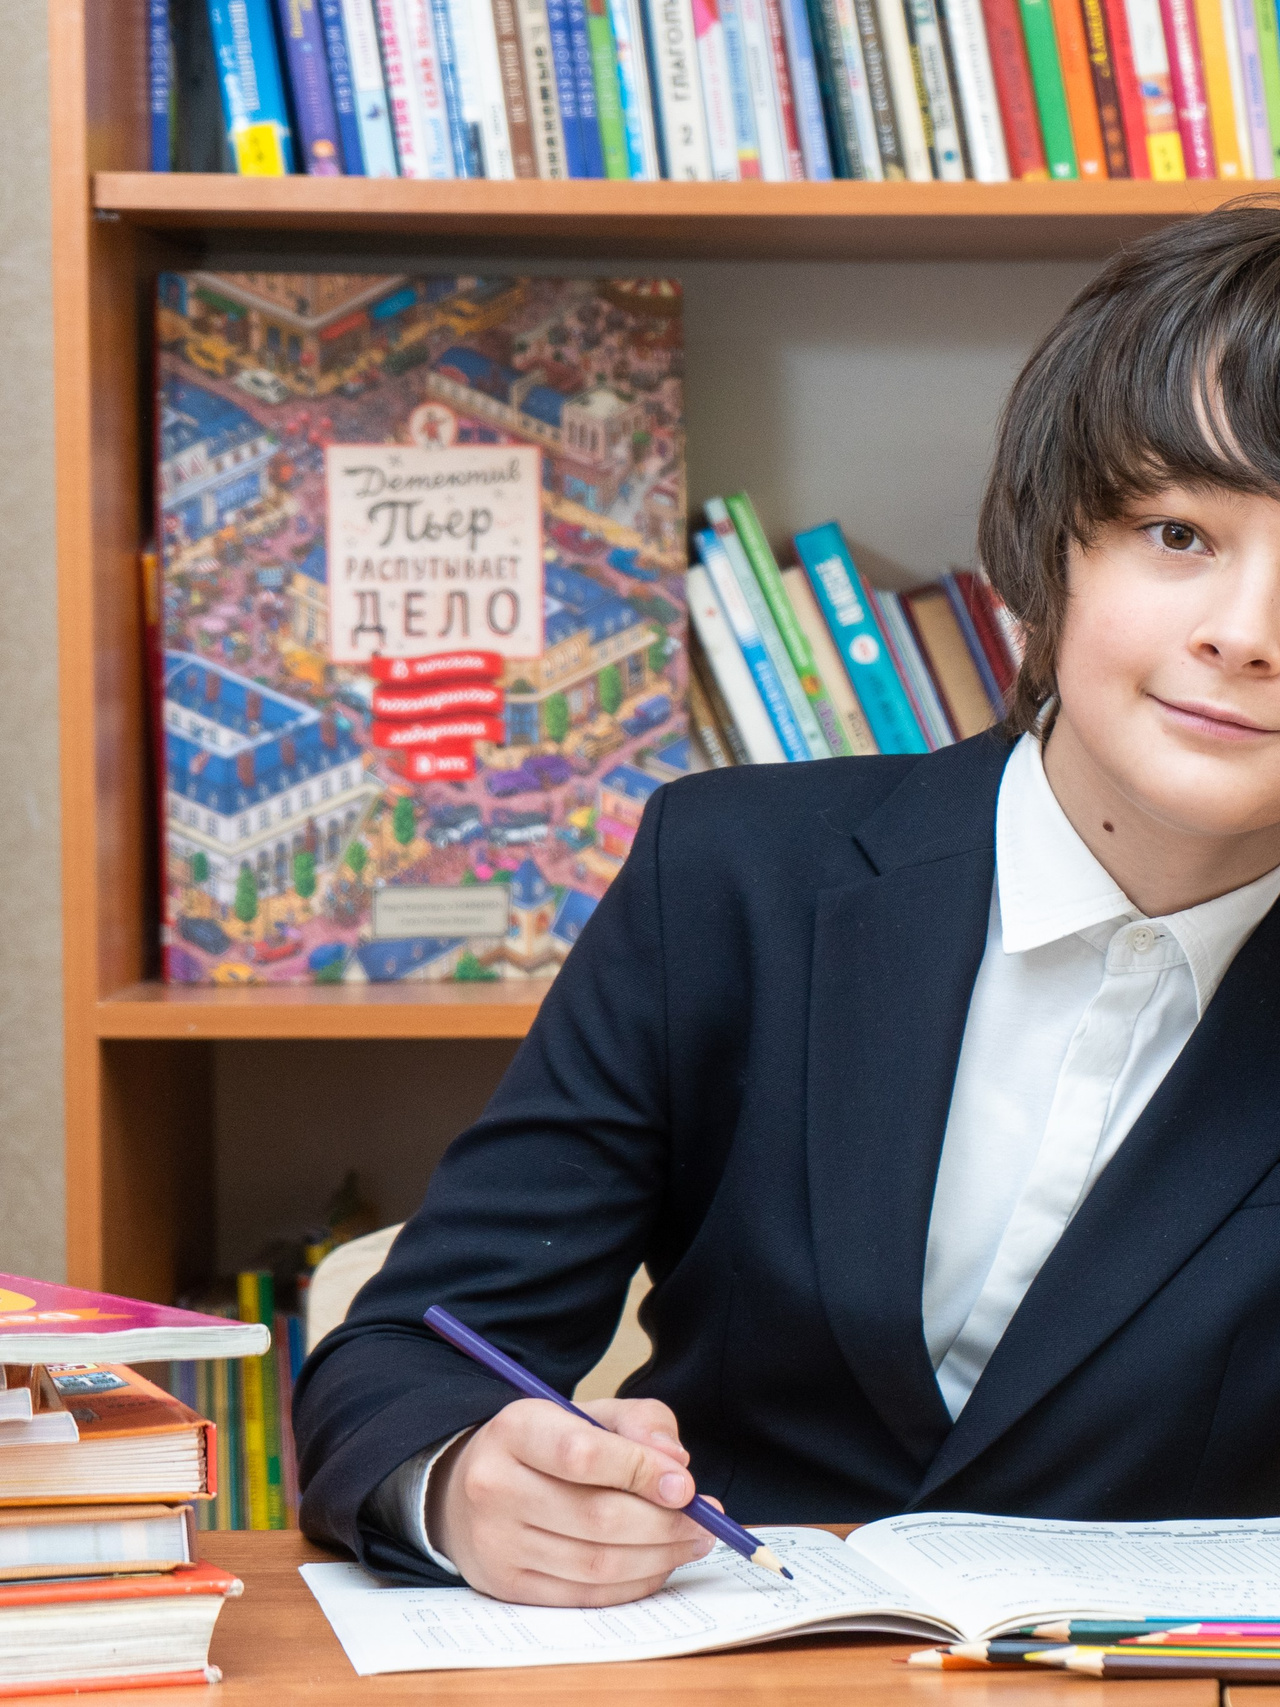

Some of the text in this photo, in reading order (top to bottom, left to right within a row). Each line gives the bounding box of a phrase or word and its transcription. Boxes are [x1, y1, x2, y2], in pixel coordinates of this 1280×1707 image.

[342, 457, 521, 499] Детектив
[368, 499, 493, 551] Пьер
[345, 556, 520, 581] РАСПУТЫВАЕТ
[351, 587, 521, 648] ДЕЛО
